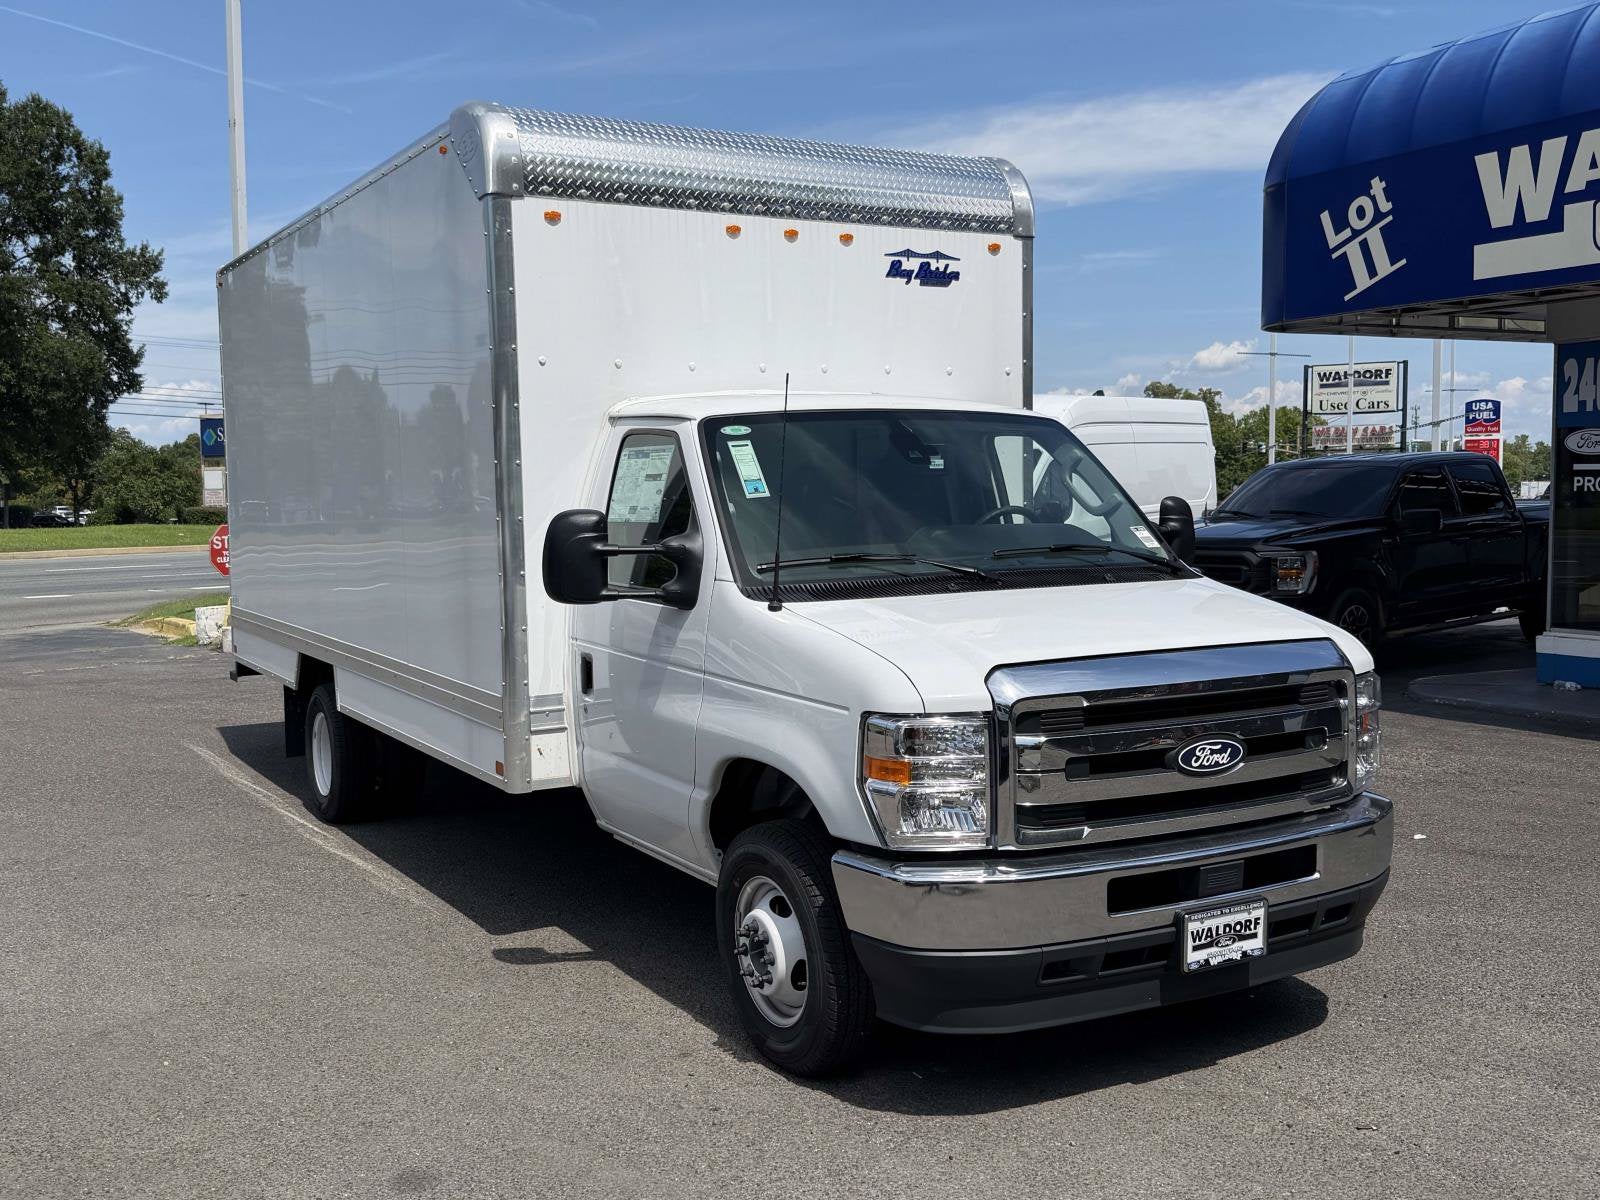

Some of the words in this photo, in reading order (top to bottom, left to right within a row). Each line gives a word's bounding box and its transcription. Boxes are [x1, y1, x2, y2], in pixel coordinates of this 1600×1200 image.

[1320, 176, 1392, 249] Lot
[1331, 214, 1407, 302] II
[1562, 357, 1600, 413] 24
[1355, 398, 1390, 410] Cars
[1469, 411, 1496, 419] FUEL
[1472, 402, 1494, 410] USA
[1576, 433, 1600, 449] For
[1191, 744, 1231, 767] Ford
[1191, 917, 1260, 943] WALDORF
